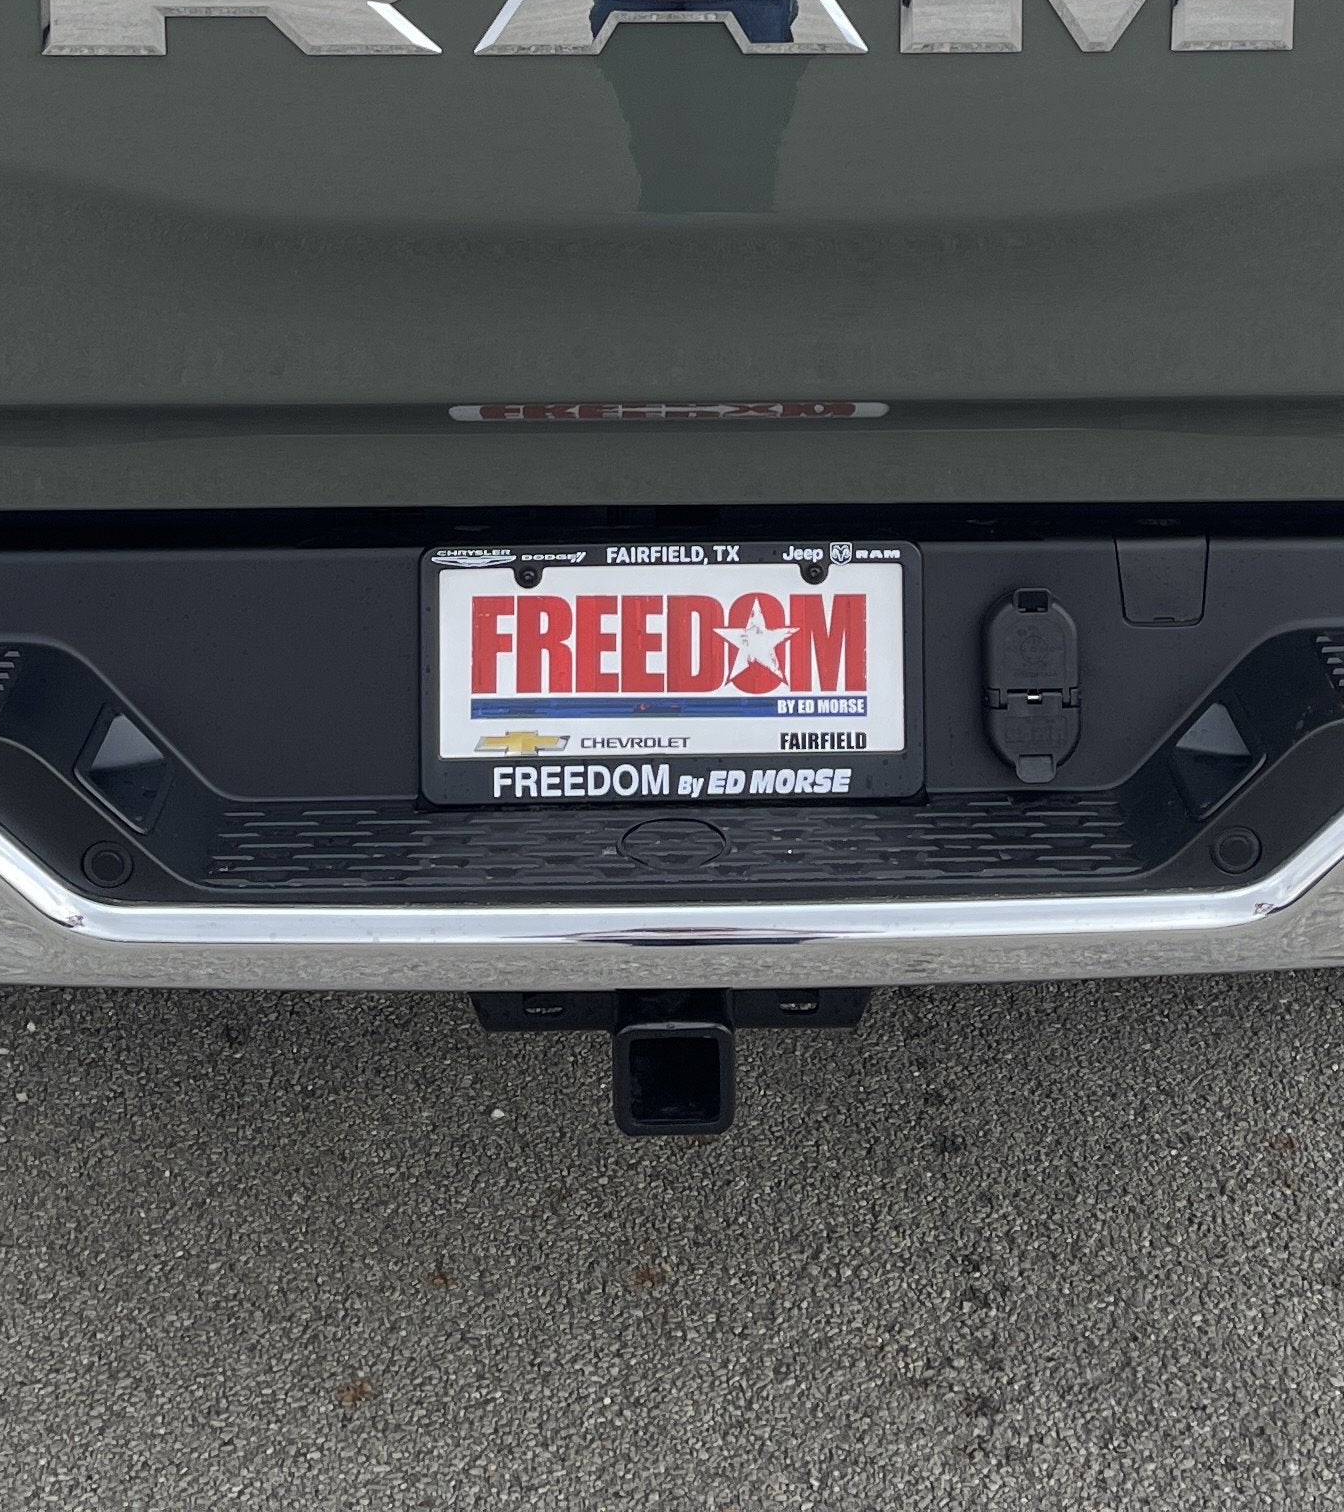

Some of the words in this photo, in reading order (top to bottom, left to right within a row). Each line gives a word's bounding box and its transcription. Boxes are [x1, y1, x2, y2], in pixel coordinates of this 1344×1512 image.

[436, 548, 511, 557] CHRYSLER
[521, 553, 578, 562] DODGE
[605, 545, 711, 565] FAIRFIELD,
[713, 544, 741, 563] TX
[782, 545, 824, 564] Jeep
[855, 548, 901, 560] RAM
[470, 591, 868, 695] FREEDOM
[776, 698, 795, 715] BY
[797, 698, 815, 715] ED
[817, 698, 865, 715] MORSE
[580, 736, 691, 750] CHEVROLET
[779, 731, 868, 751] FAIRFIELD
[493, 763, 671, 798] FREEDOM
[706, 770, 746, 795] ED
[747, 767, 852, 794] MORSE
